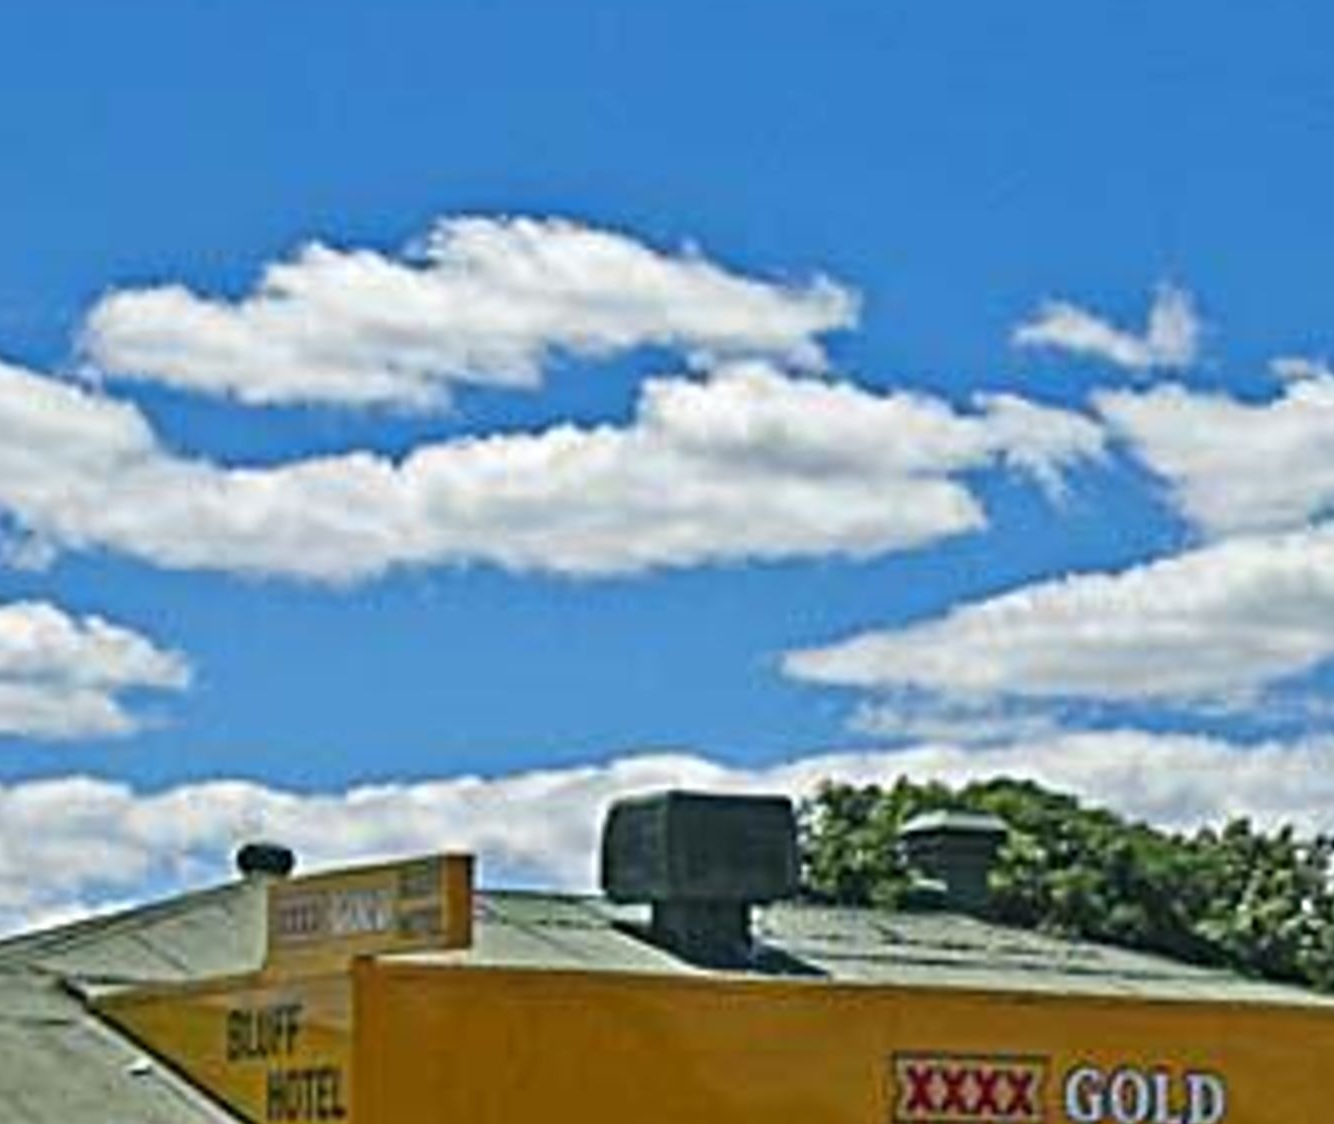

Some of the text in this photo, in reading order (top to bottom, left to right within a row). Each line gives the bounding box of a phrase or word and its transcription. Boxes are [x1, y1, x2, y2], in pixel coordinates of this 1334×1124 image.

[226, 1003, 303, 1060] BLUFF
[267, 1066, 347, 1121] HOTEL
[898, 1058, 1042, 1123] XXXX
